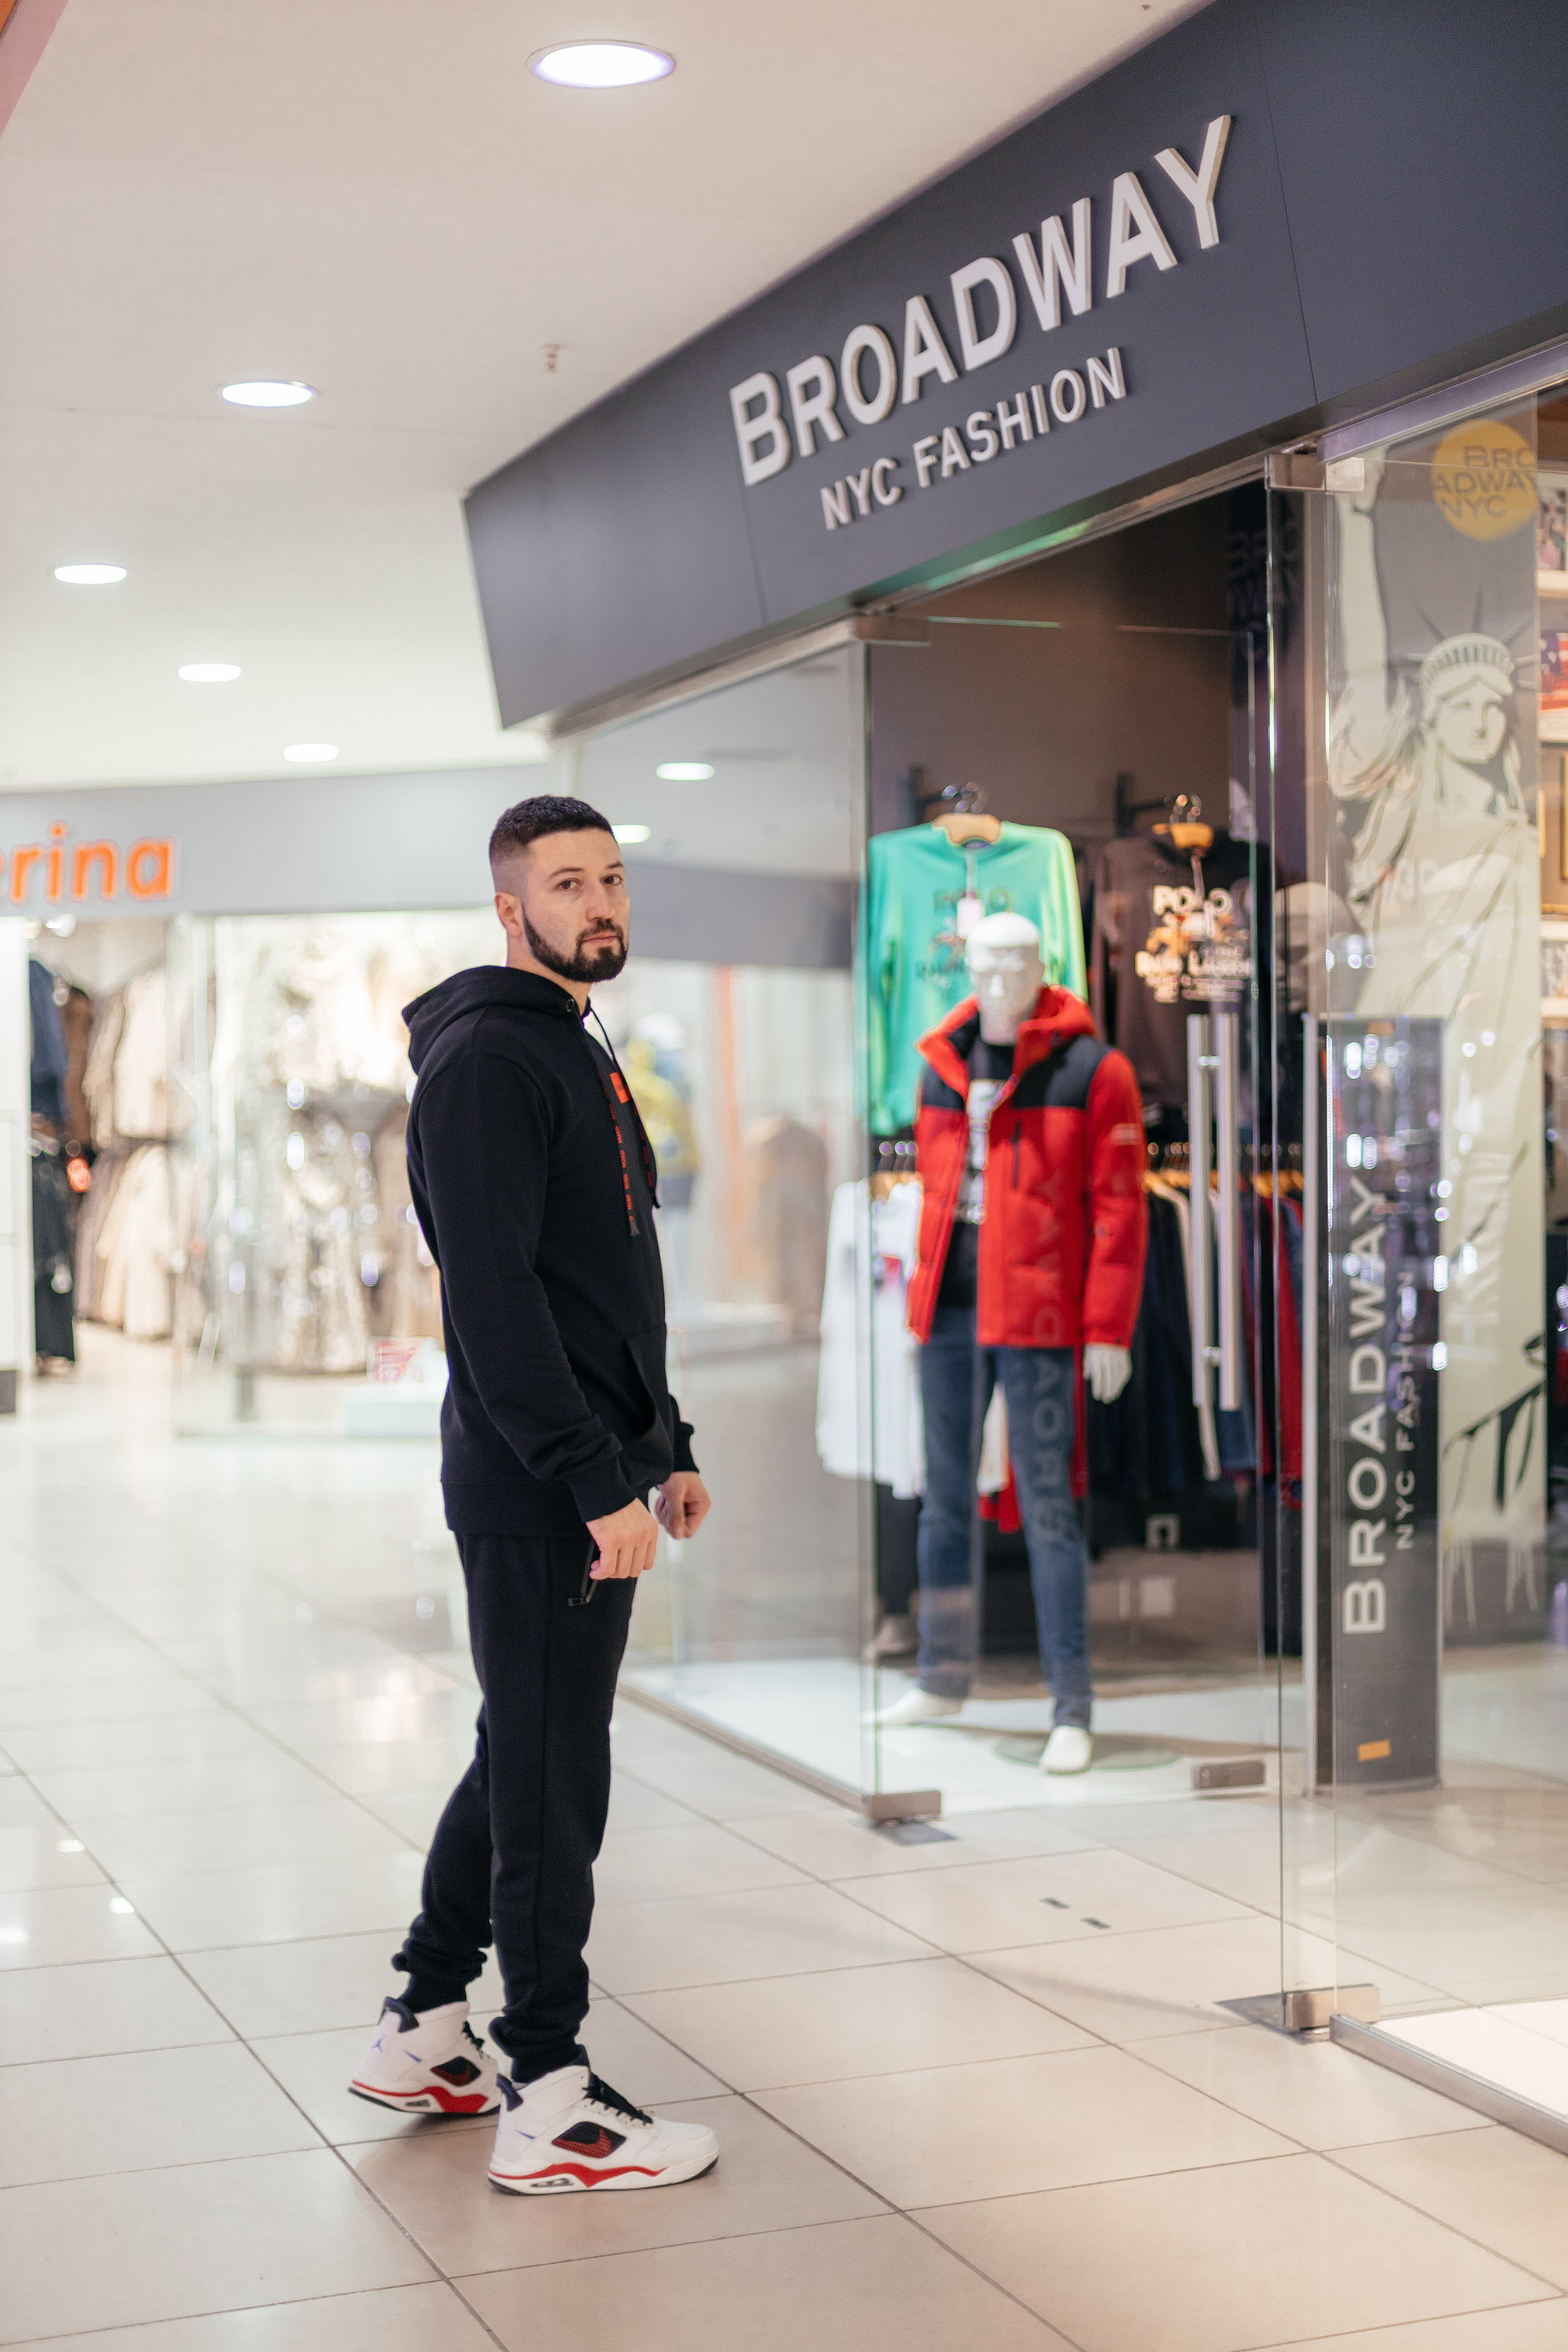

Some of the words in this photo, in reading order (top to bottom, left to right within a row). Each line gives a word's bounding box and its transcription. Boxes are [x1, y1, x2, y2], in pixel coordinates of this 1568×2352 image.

[729, 114, 1231, 486] BROADWAY
[820, 458, 903, 530] NYC
[913, 347, 1128, 488] FASHION
[1441, 495, 1506, 519] NYC
[0, 820, 177, 906] rina
[1153, 884, 1232, 917] POO
[1342, 1173, 1387, 1635] BROADWAY
[1395, 1470, 1415, 1550] NYC
